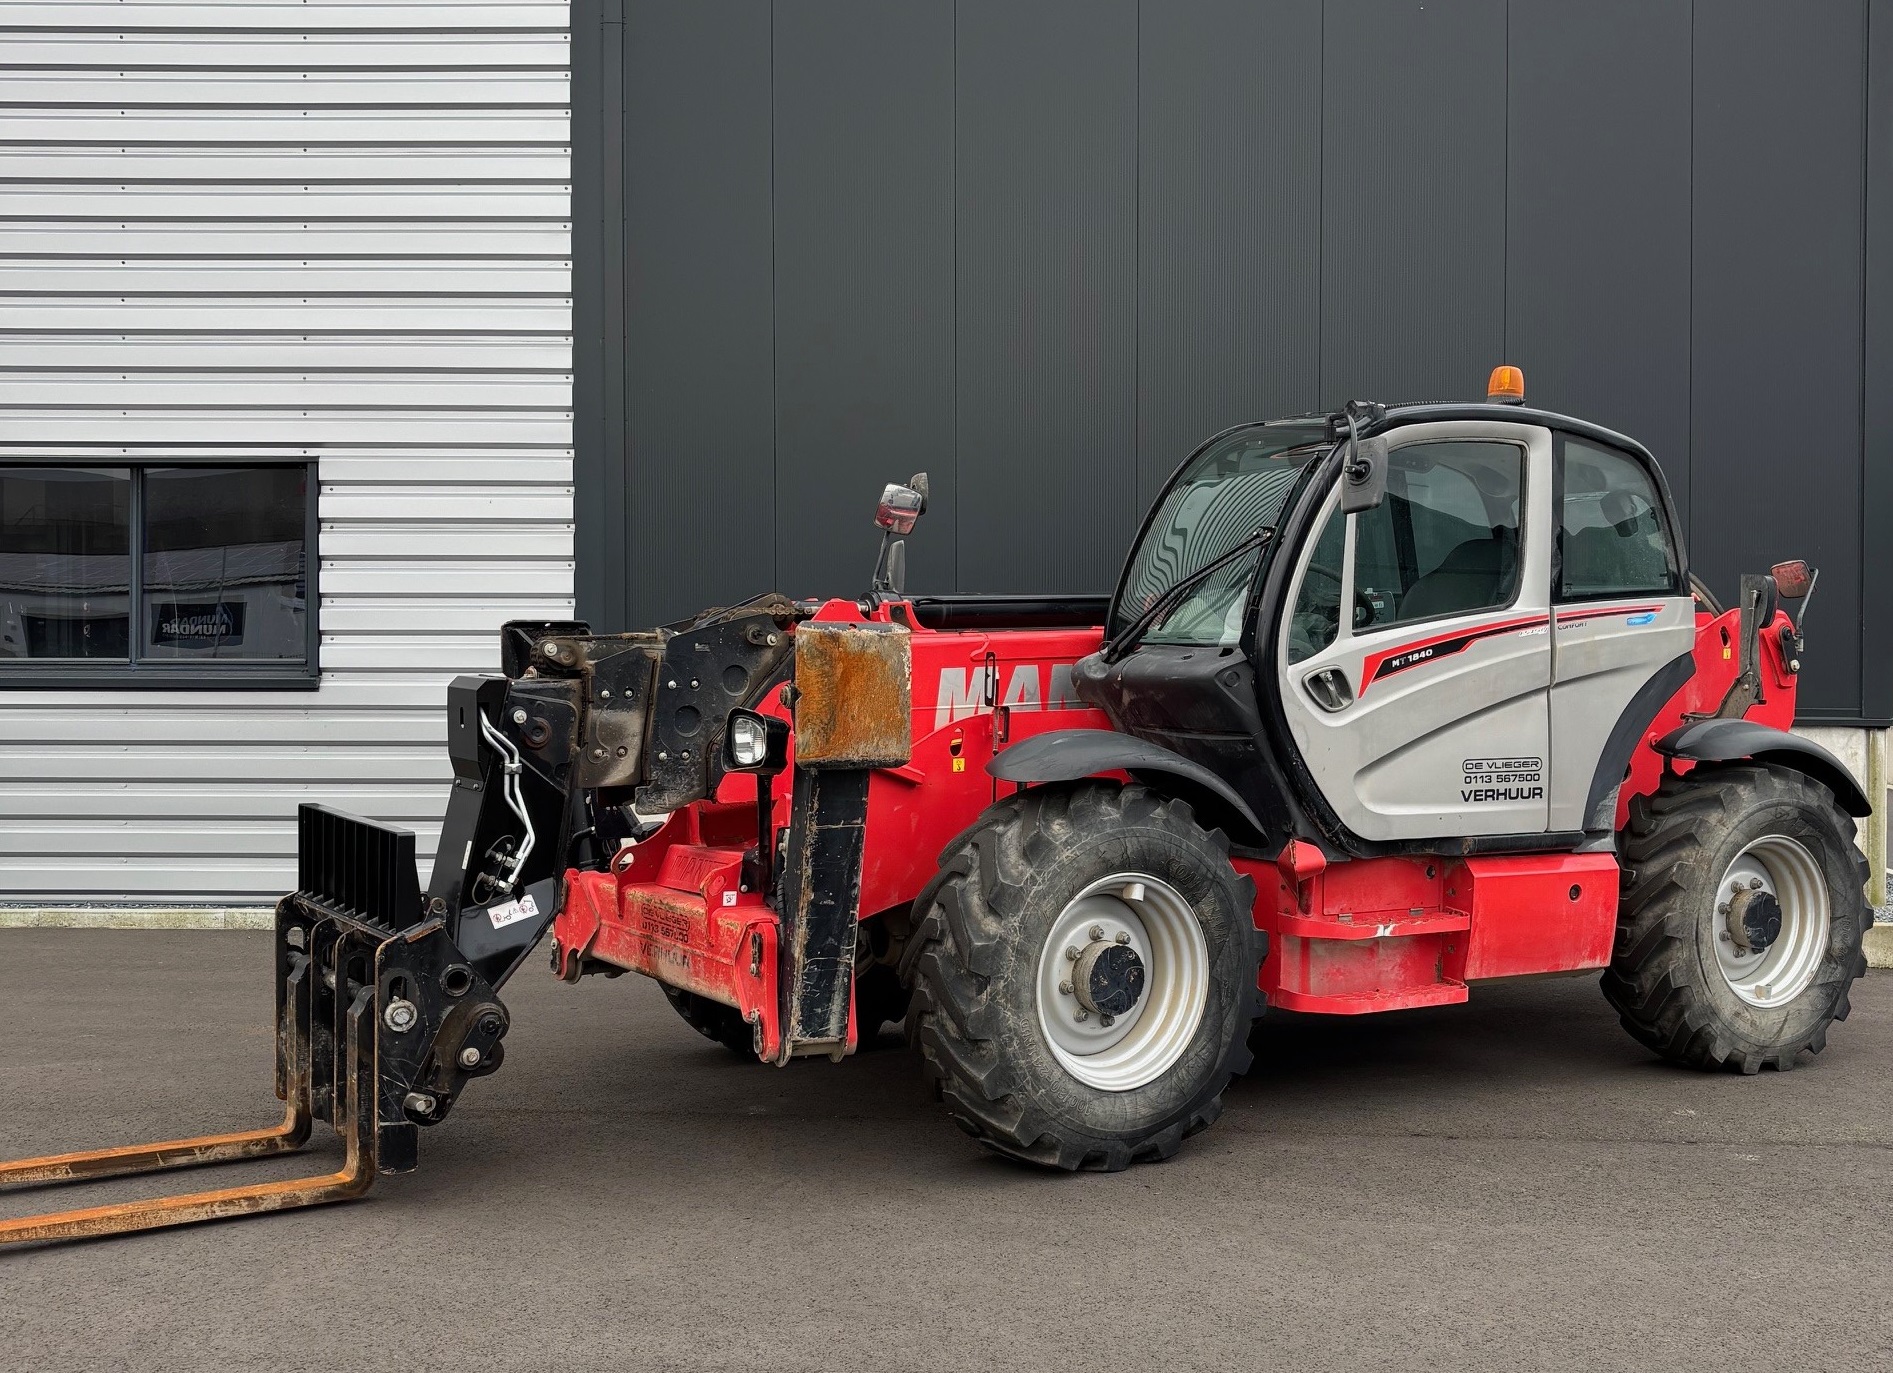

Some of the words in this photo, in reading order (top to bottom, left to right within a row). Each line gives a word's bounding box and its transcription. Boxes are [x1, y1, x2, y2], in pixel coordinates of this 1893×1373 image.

[1391, 656, 1407, 668] MT
[1407, 648, 1433, 662] 1840
[1465, 762, 1484, 770] DE
[1486, 760, 1540, 769] VLIEGER
[1464, 774, 1492, 784] 0113
[1496, 773, 1541, 783] 567500
[1461, 786, 1543, 802] VERHUUR
